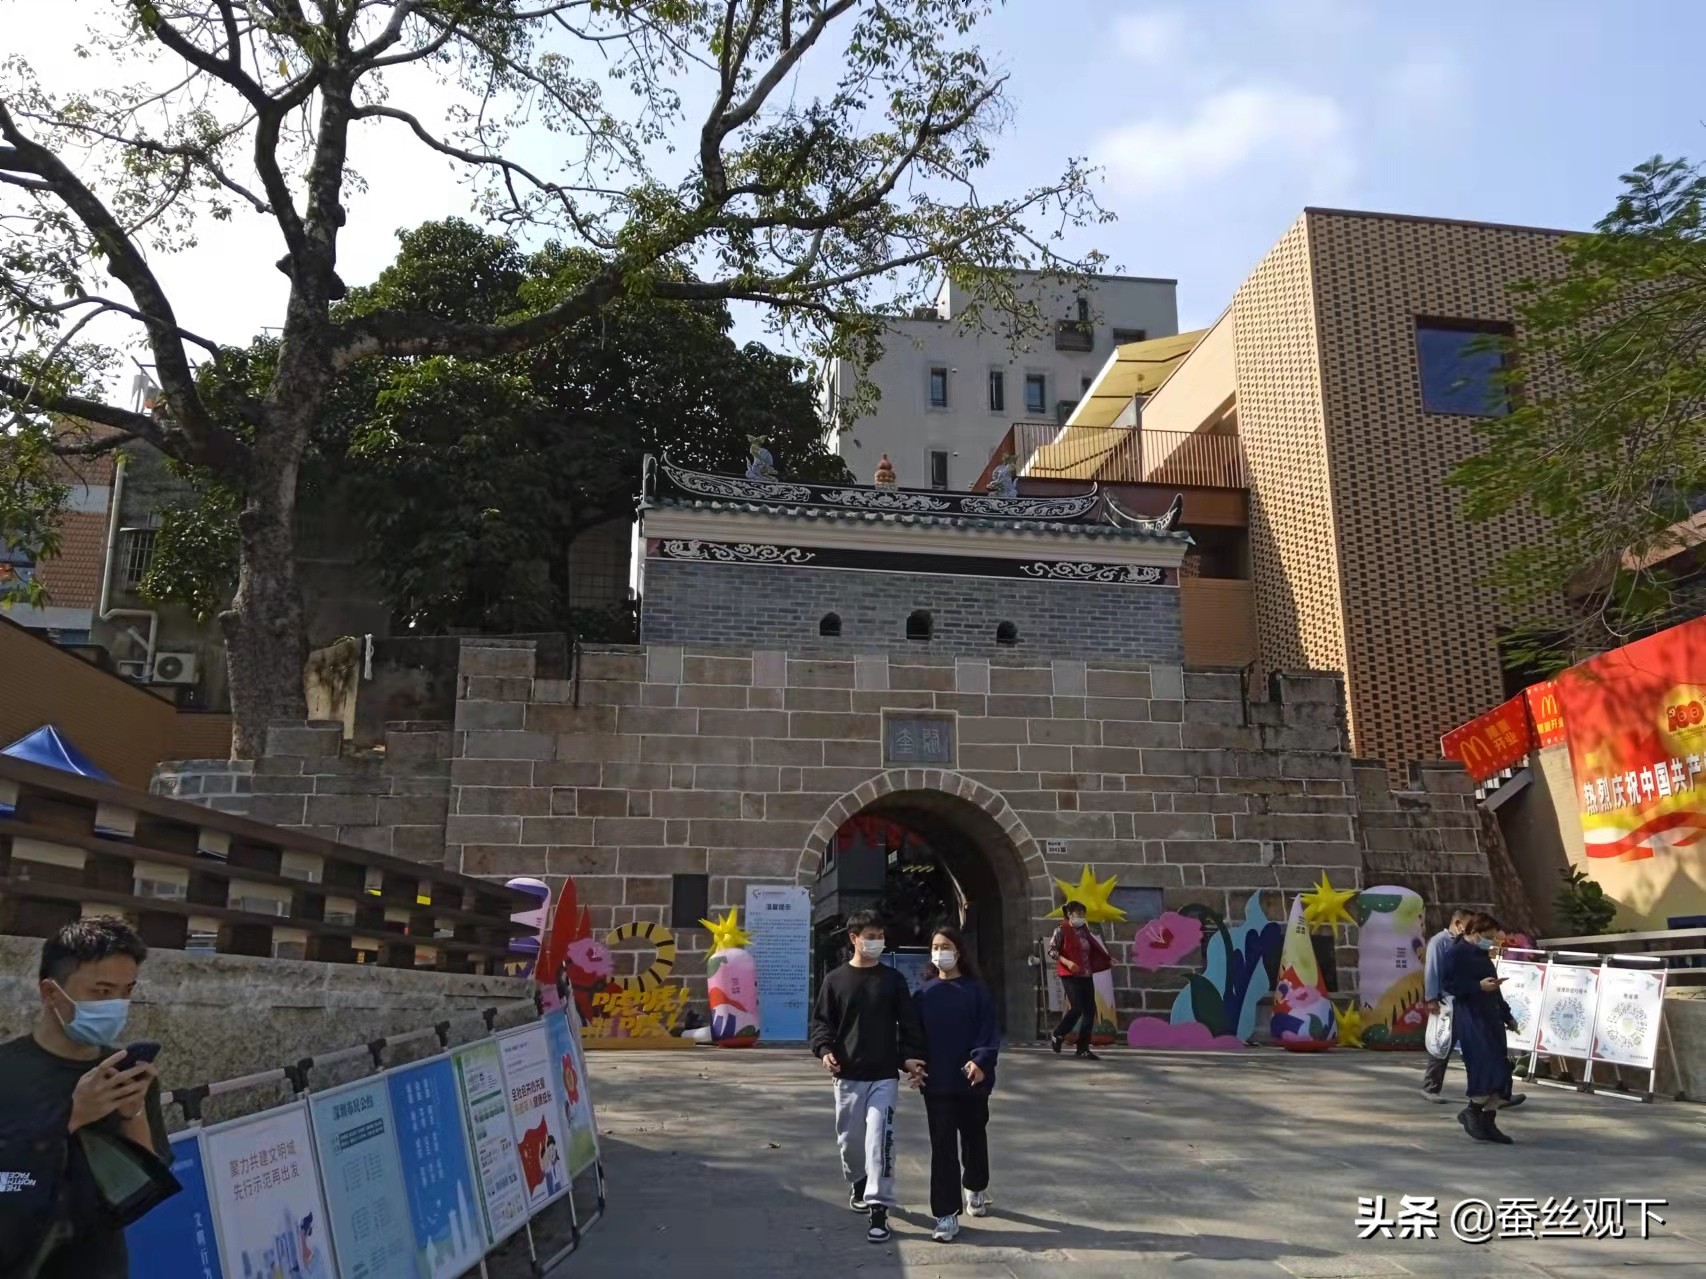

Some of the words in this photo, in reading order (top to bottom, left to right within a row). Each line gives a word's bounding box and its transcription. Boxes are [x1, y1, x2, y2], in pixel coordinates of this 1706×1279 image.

[1583, 750, 1706, 817] 热烈庆祝中国共产
[8, 1171, 31, 1179] FACE
[7, 1178, 37, 1187] NORTH
[233, 1160, 301, 1202] 先行示范再出发
[6, 1184, 22, 1192] THE
